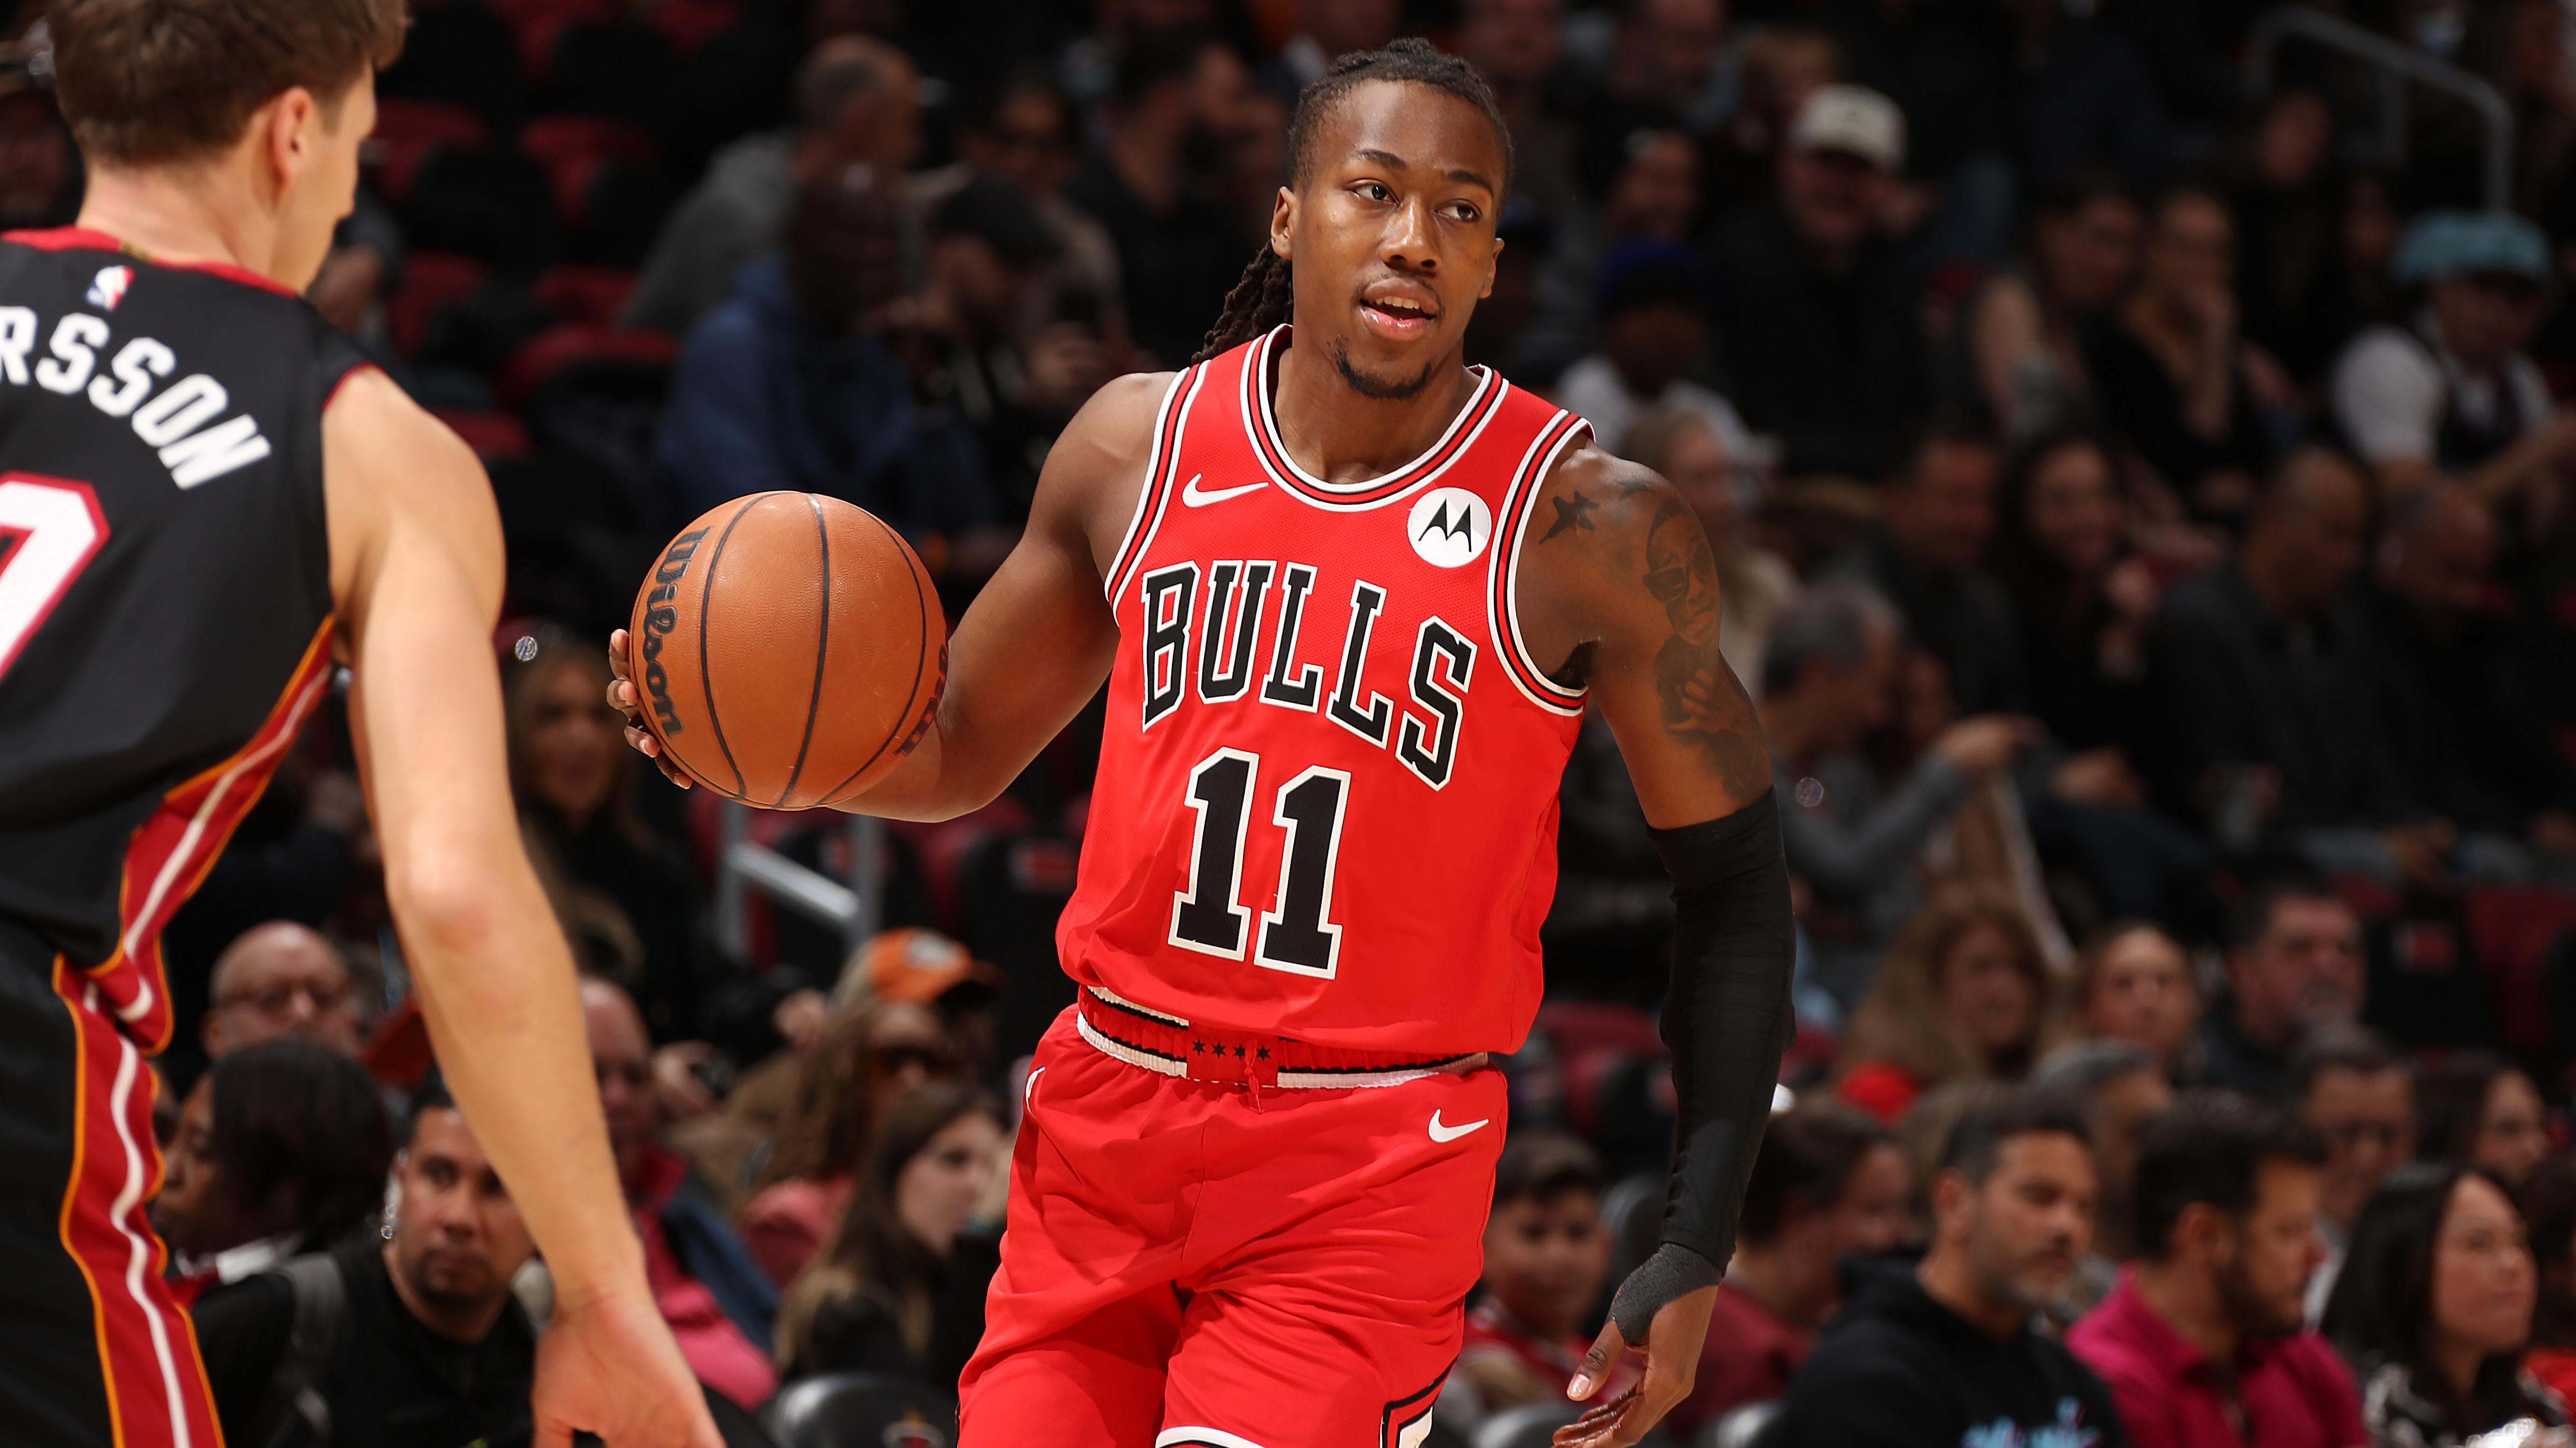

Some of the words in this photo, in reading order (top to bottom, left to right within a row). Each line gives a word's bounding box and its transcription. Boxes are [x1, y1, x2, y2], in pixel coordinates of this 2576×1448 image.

[643, 525, 714, 739] Wilson
[1141, 560, 1478, 791] BULLS
[1168, 747, 1351, 980] 11
